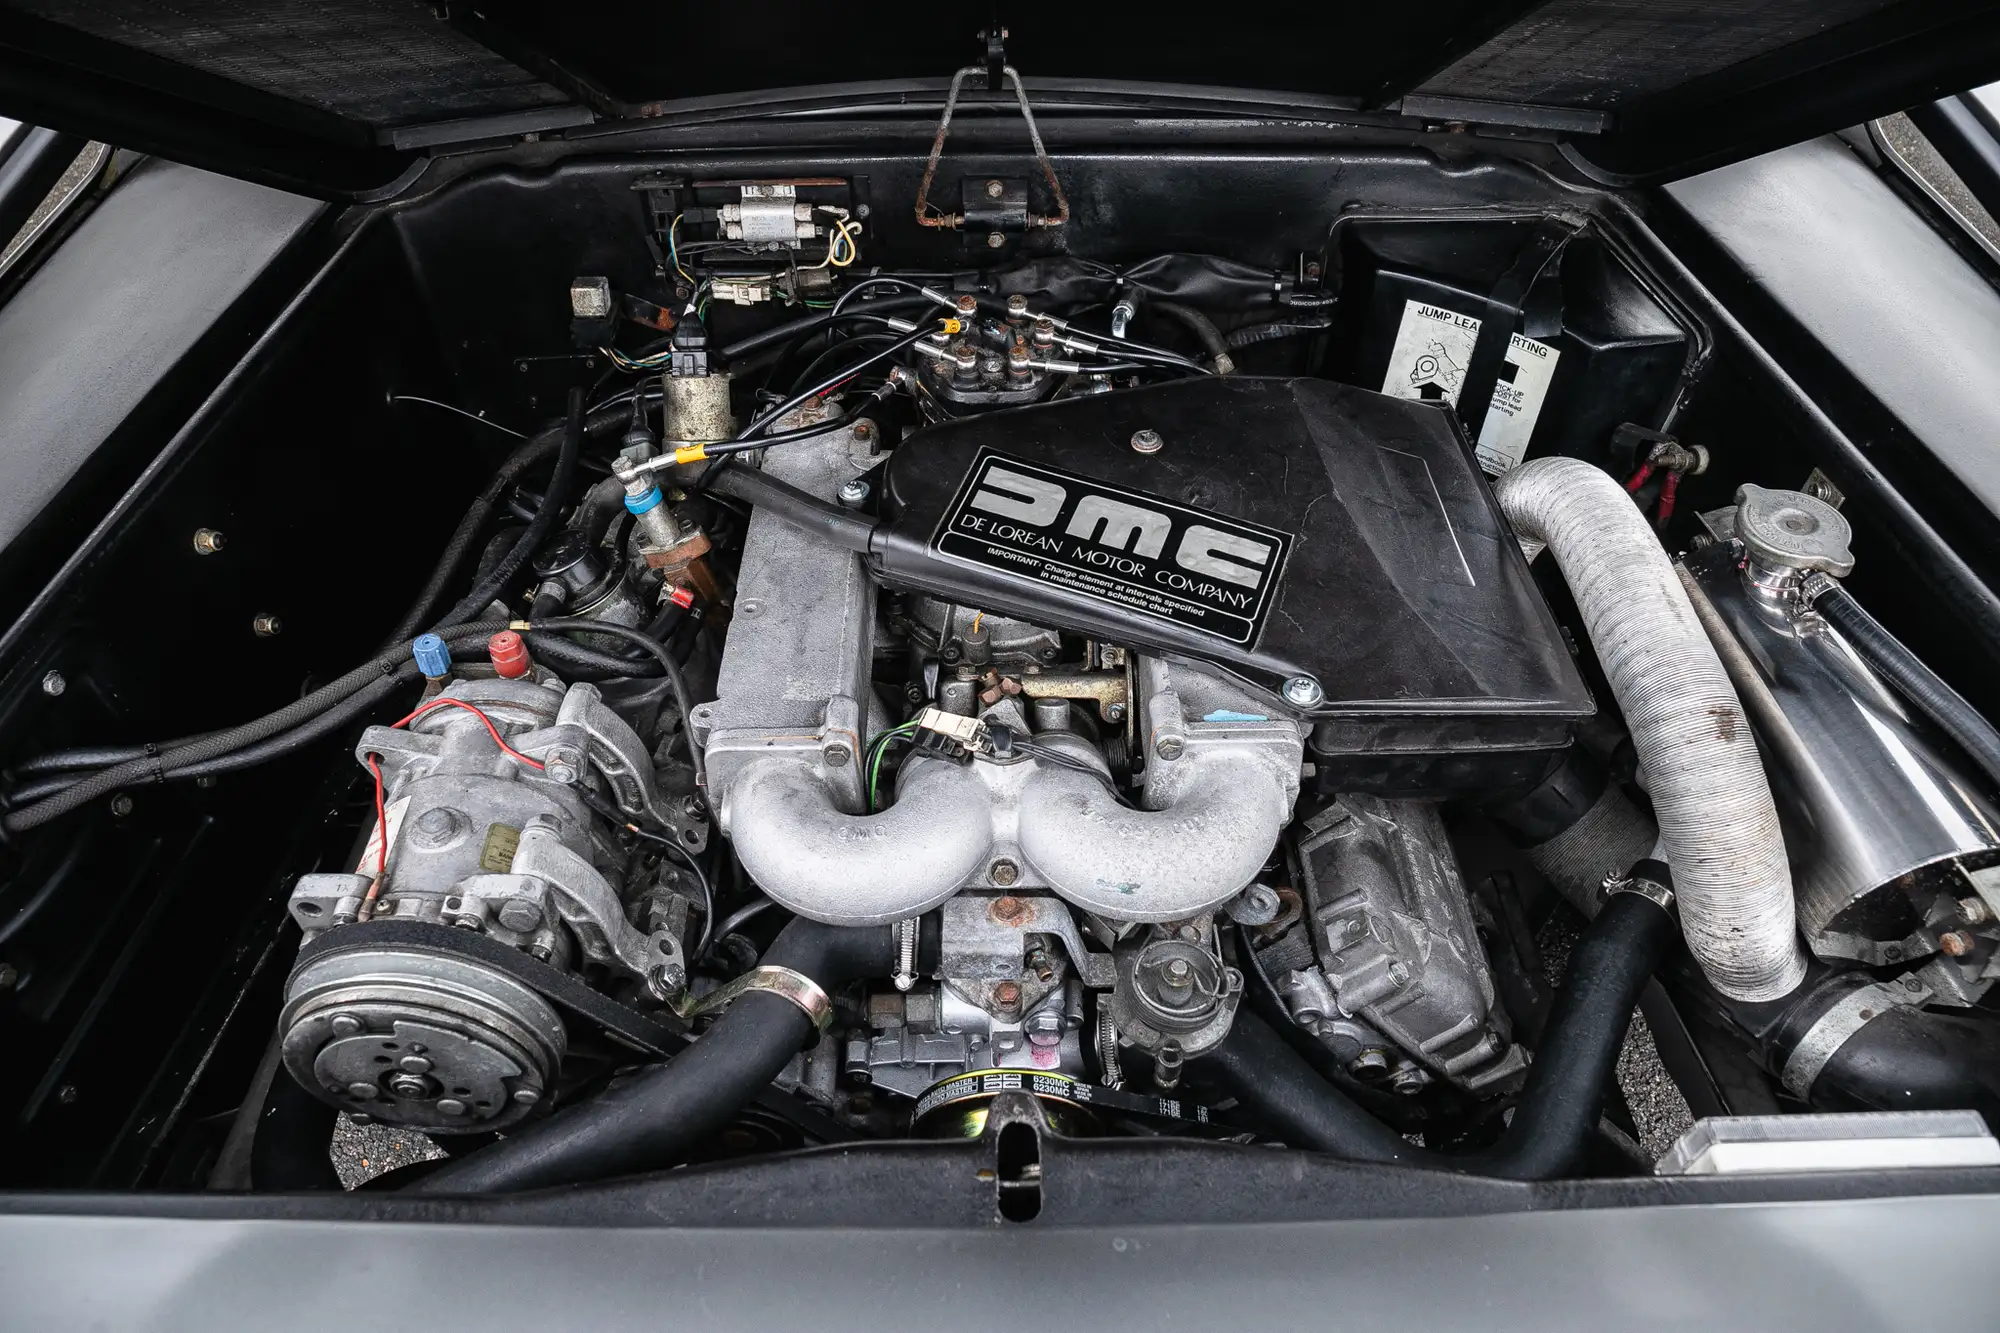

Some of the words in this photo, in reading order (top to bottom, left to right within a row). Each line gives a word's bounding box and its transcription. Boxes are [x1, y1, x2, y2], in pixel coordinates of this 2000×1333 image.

[1417, 306, 1452, 321] JUMP
[1454, 316, 1478, 331] LEA
[1511, 336, 1548, 357] RTING
[1492, 397, 1508, 407] ump
[1508, 402, 1522, 412] lead
[960, 513, 988, 532] DE
[989, 521, 1064, 554] LOREAN
[1071, 545, 1147, 578] MOTOR
[1155, 570, 1254, 610] COMPANY
[1040, 570, 1049, 578] in
[1050, 574, 1106, 595] maintenance
[1107, 590, 1148, 607] schedule
[1148, 602, 1173, 615] chart
[1044, 563, 1077, 578] Change
[1078, 573, 1114, 589] element
[1114, 584, 1125, 592] at
[1125, 586, 1163, 604] intervals
[1163, 599, 1206, 617] specified
[946, 1078, 973, 1091] MASTER
[1033, 1075, 1070, 1089] 6230MC
[946, 1086, 973, 1099] MASTER
[1033, 1083, 1070, 1097] 6230MC
